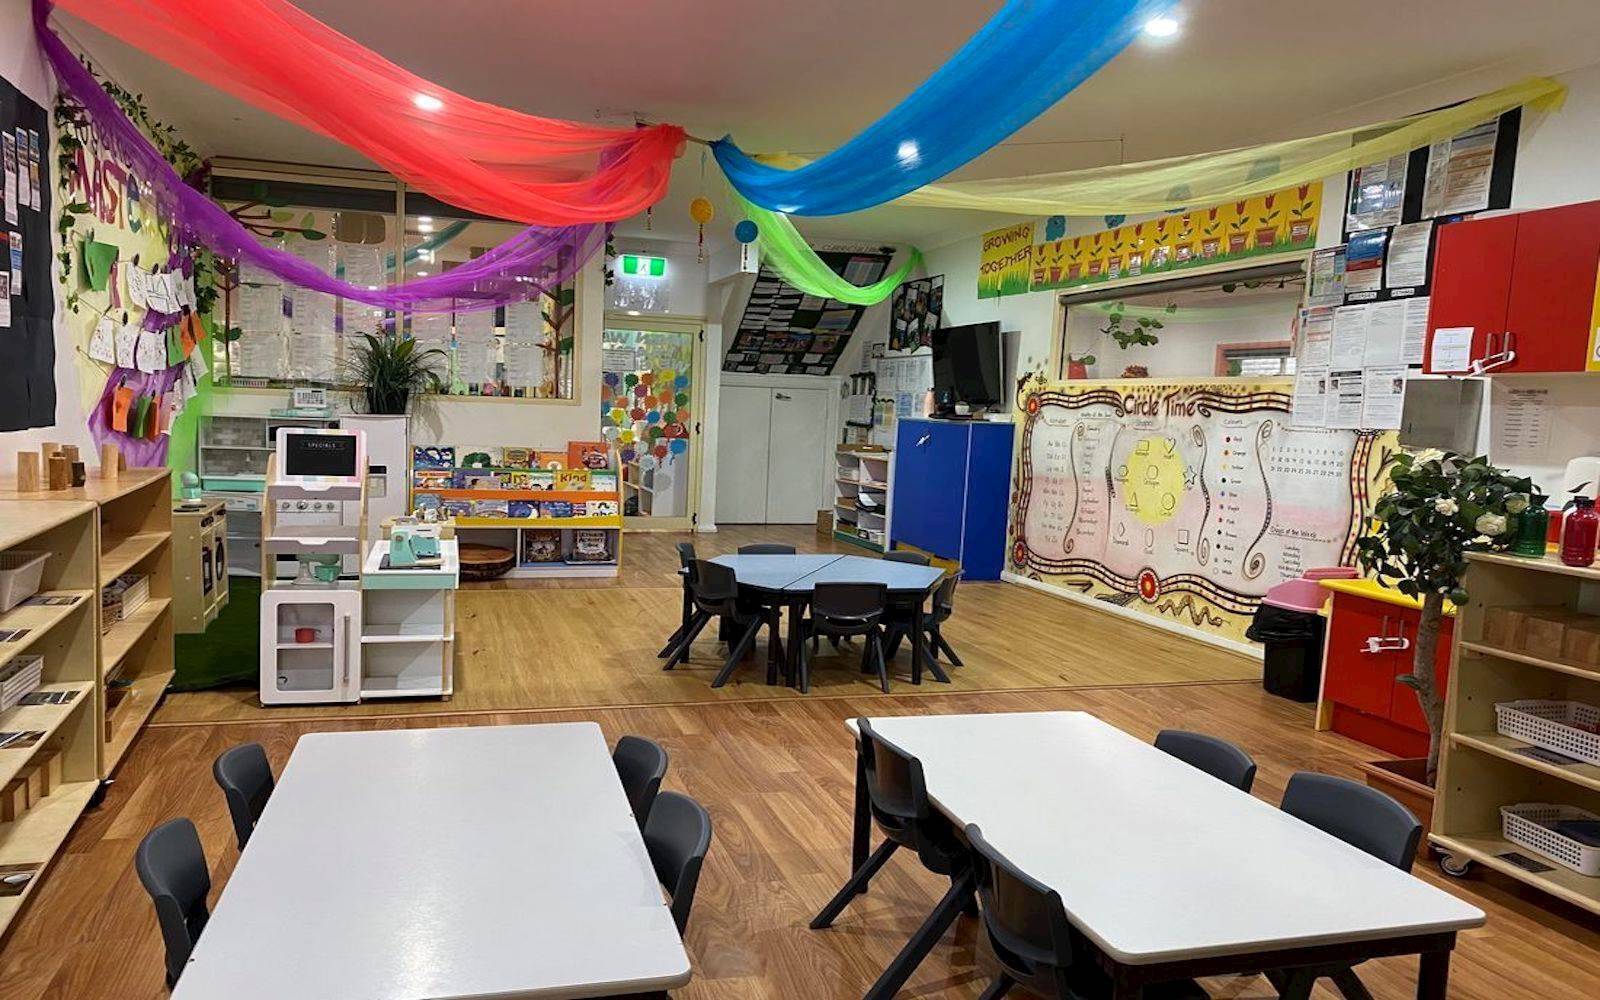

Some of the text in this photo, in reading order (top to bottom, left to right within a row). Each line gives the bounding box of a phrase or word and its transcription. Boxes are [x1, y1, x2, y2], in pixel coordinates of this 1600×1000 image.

[983, 226, 1030, 252] GROWING
[980, 245, 1032, 274] TOGETHER
[1124, 389, 1197, 417] Circle Time
[560, 473, 587, 482] Kind
